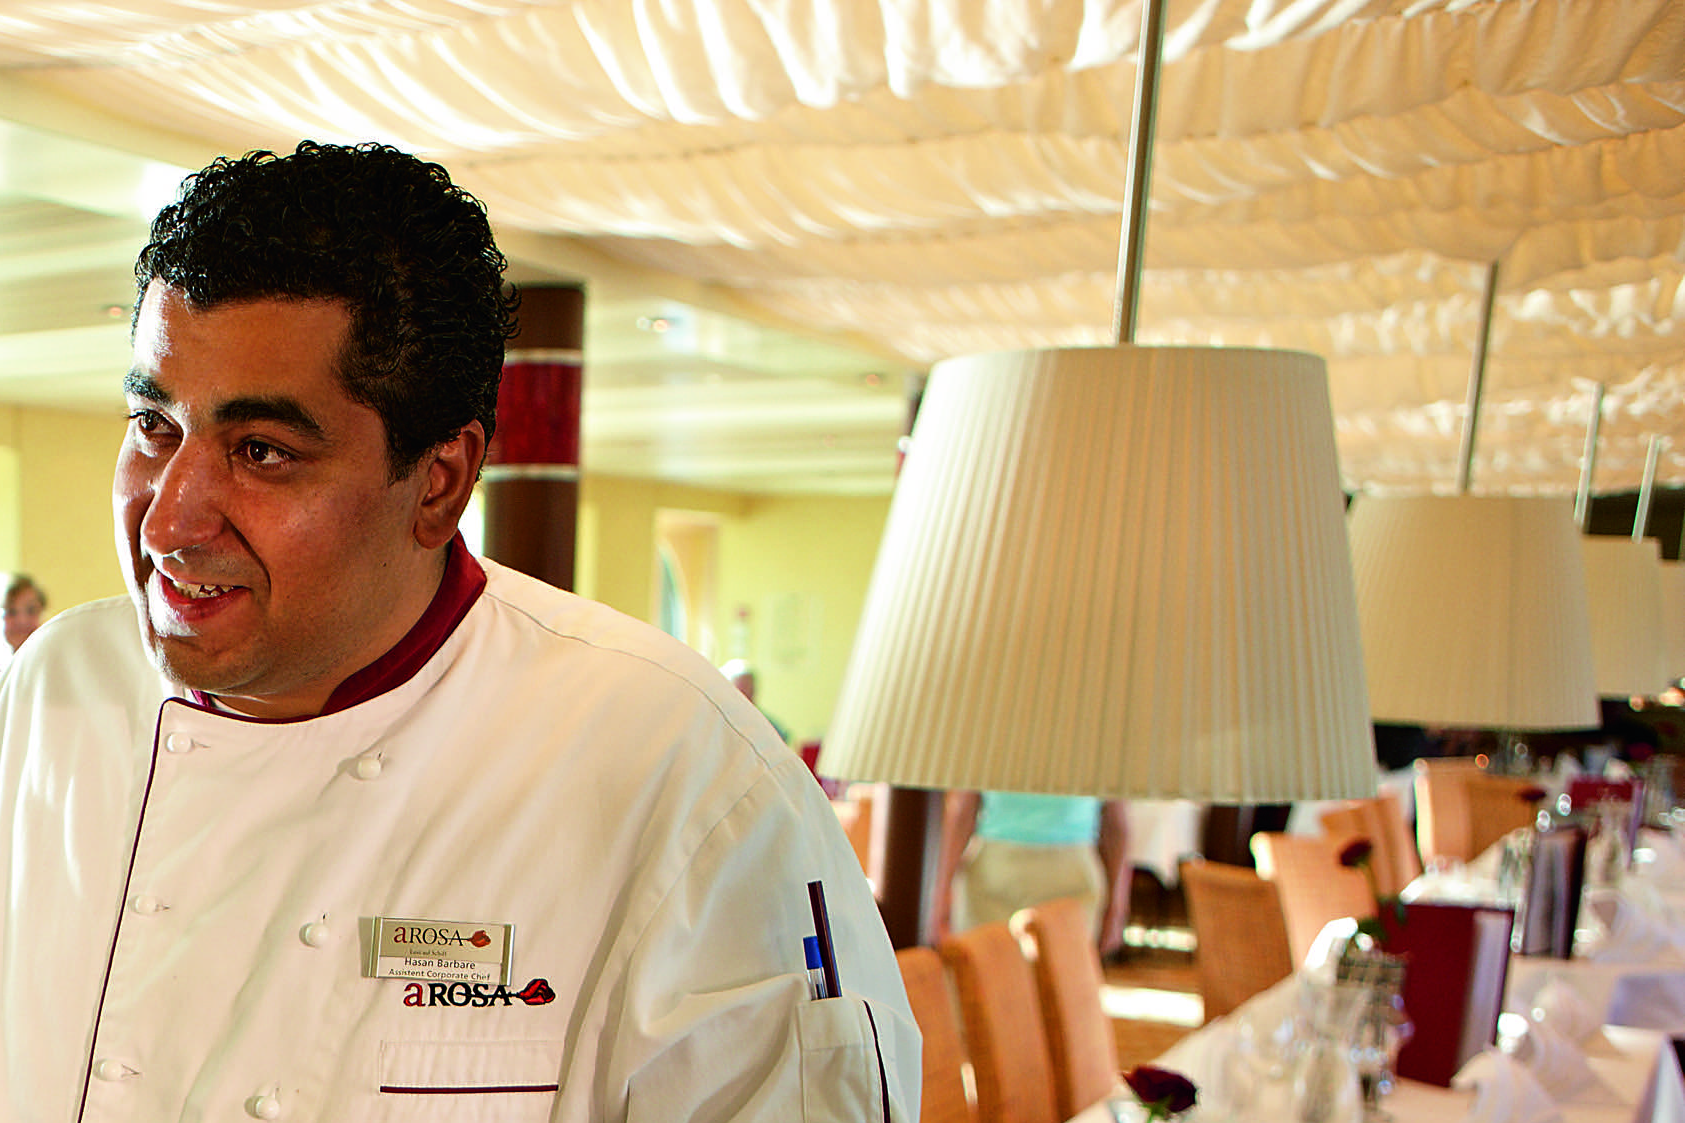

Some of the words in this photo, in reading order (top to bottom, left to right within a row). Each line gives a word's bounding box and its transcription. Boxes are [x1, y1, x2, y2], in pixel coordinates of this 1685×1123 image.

[404, 956, 434, 967] Hasan
[437, 958, 476, 970] Barbare
[426, 970, 469, 980] Corporate
[471, 972, 491, 981] Chef
